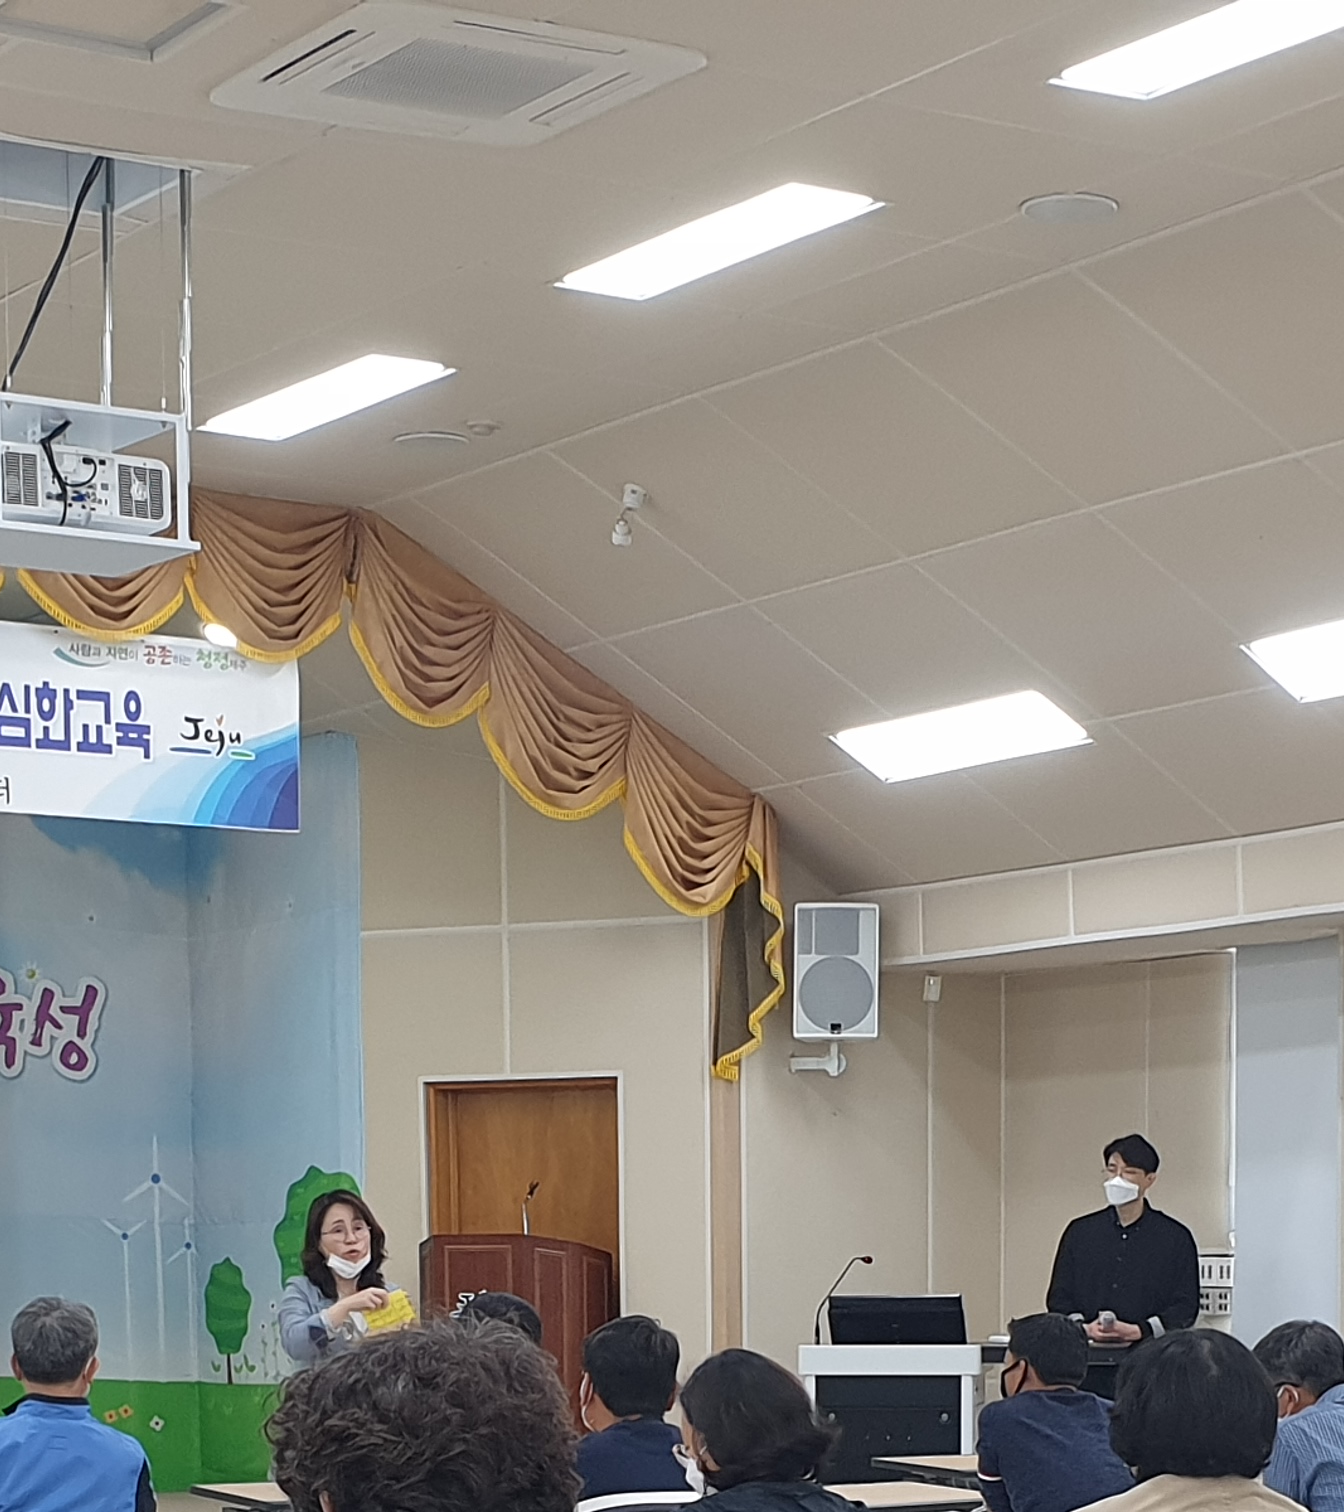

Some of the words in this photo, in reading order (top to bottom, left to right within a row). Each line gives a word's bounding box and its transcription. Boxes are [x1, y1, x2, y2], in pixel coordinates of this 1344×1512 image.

[69, 642, 101, 657] 사람과
[143, 644, 192, 667] 공존하는
[179, 714, 242, 757] Jeju
